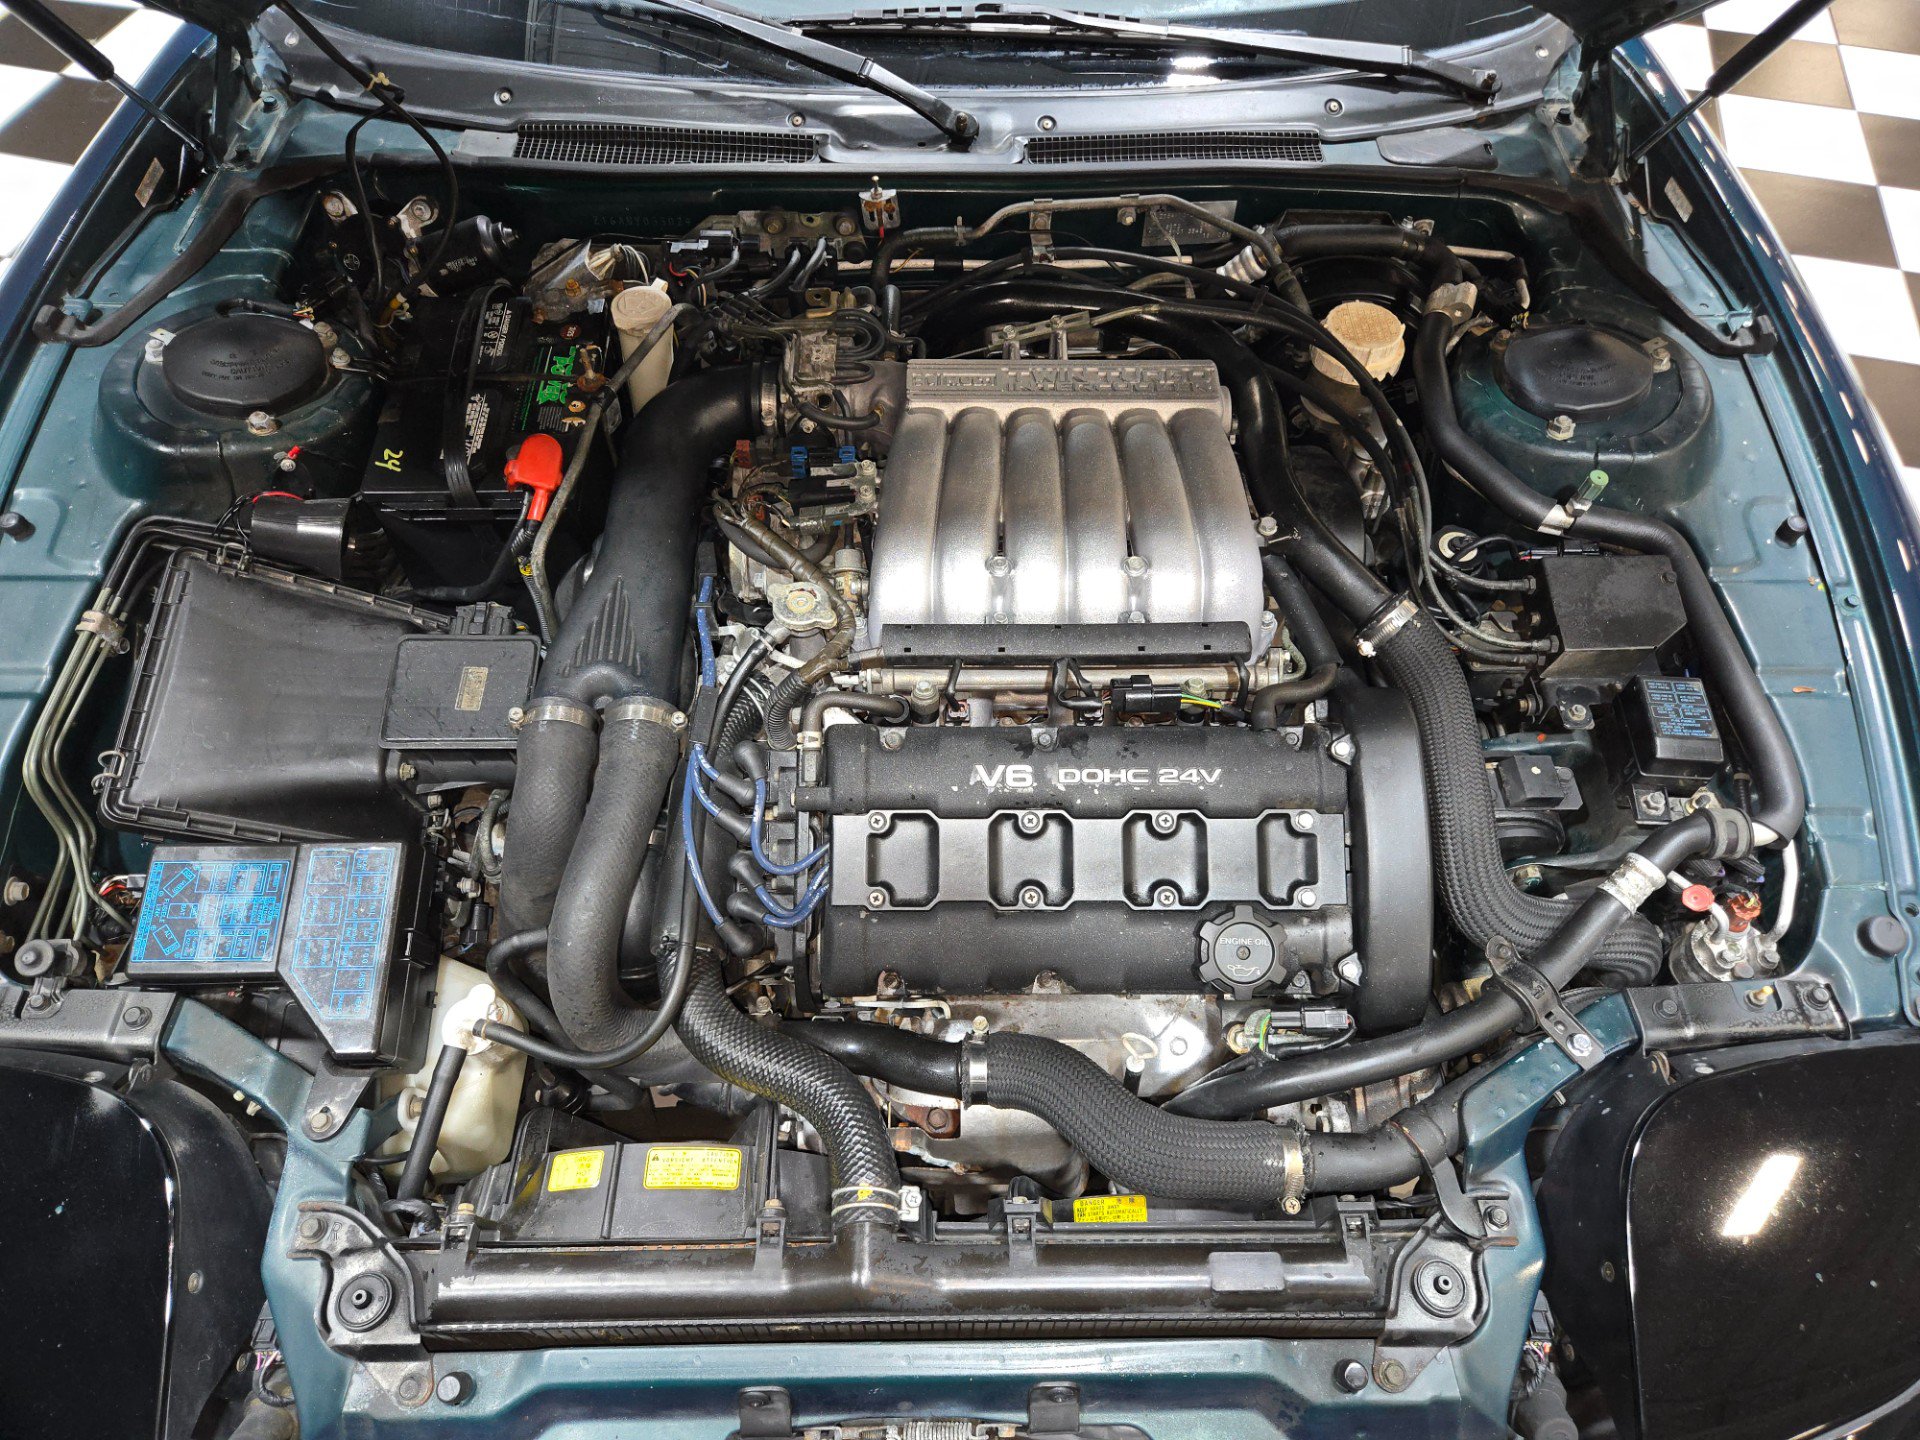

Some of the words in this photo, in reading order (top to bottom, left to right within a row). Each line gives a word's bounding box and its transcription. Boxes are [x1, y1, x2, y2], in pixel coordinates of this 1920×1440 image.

[374, 448, 404, 472] 24
[974, 764, 1034, 788] V6
[1058, 768, 1150, 784] DOHC
[1158, 768, 1222, 784] 24V
[1219, 937, 1253, 946] ENGINE
[1254, 938, 1271, 947] OIL
[1080, 1199, 1105, 1207] DANGER
